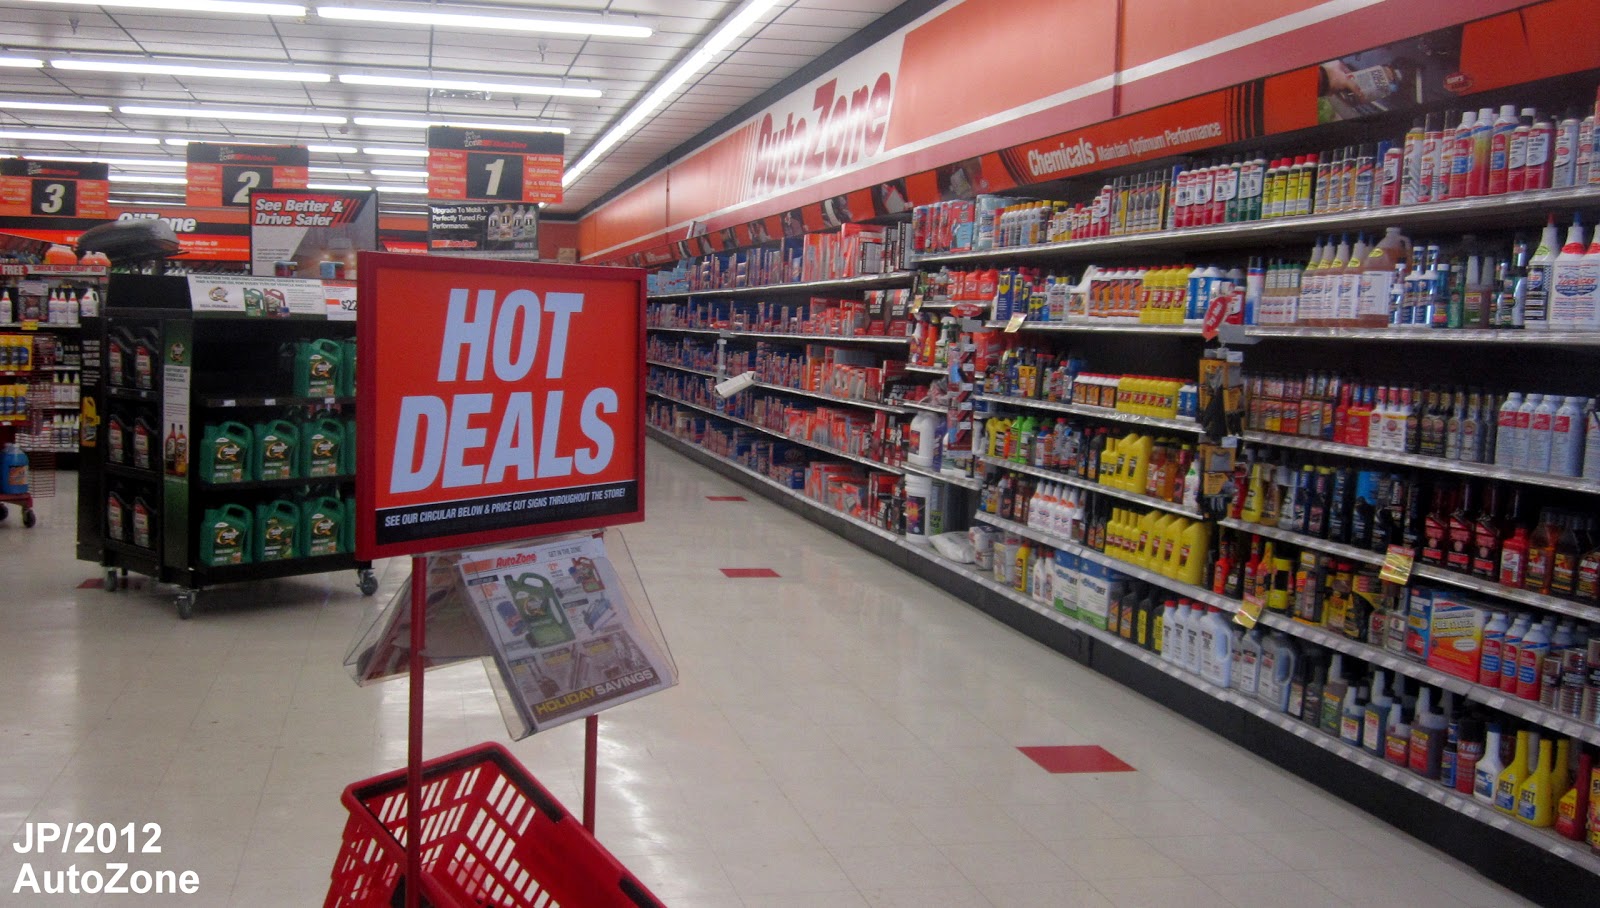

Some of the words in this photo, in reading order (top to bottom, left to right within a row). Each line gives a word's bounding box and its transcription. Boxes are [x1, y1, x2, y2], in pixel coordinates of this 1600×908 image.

[752, 72, 891, 196] AutoZone
[1028, 138, 1095, 176] Chemicals
[1096, 144, 1129, 162] Maintain
[1129, 134, 1164, 156] Optimum
[1165, 121, 1221, 146] Performance
[230, 171, 260, 204] 2
[485, 159, 505, 196] 1
[41, 184, 65, 213] 3
[255, 198, 281, 212] See
[285, 199, 328, 213] Better
[331, 201, 343, 213] &
[432, 207, 457, 215] Upgrade
[255, 212, 292, 225] Drive
[294, 213, 333, 226] Safer
[432, 214, 458, 223] Perfectly
[4, 266, 24, 275] FREE
[437, 288, 584, 382] HOT
[389, 387, 618, 494] DEALS
[385, 516, 400, 527] SEE
[402, 514, 418, 524] OUR
[419, 510, 456, 523] CIRCULAR
[457, 508, 482, 518] BELOW
[484, 506, 490, 515] &
[491, 503, 512, 514] PRICE
[513, 502, 526, 510] CUT
[527, 497, 547, 508] SIGNS
[549, 494, 590, 506] THROUGHOUT
[591, 491, 603, 500] THE
[604, 488, 626, 498] STORE!
[496, 552, 537, 568] AutoZone
